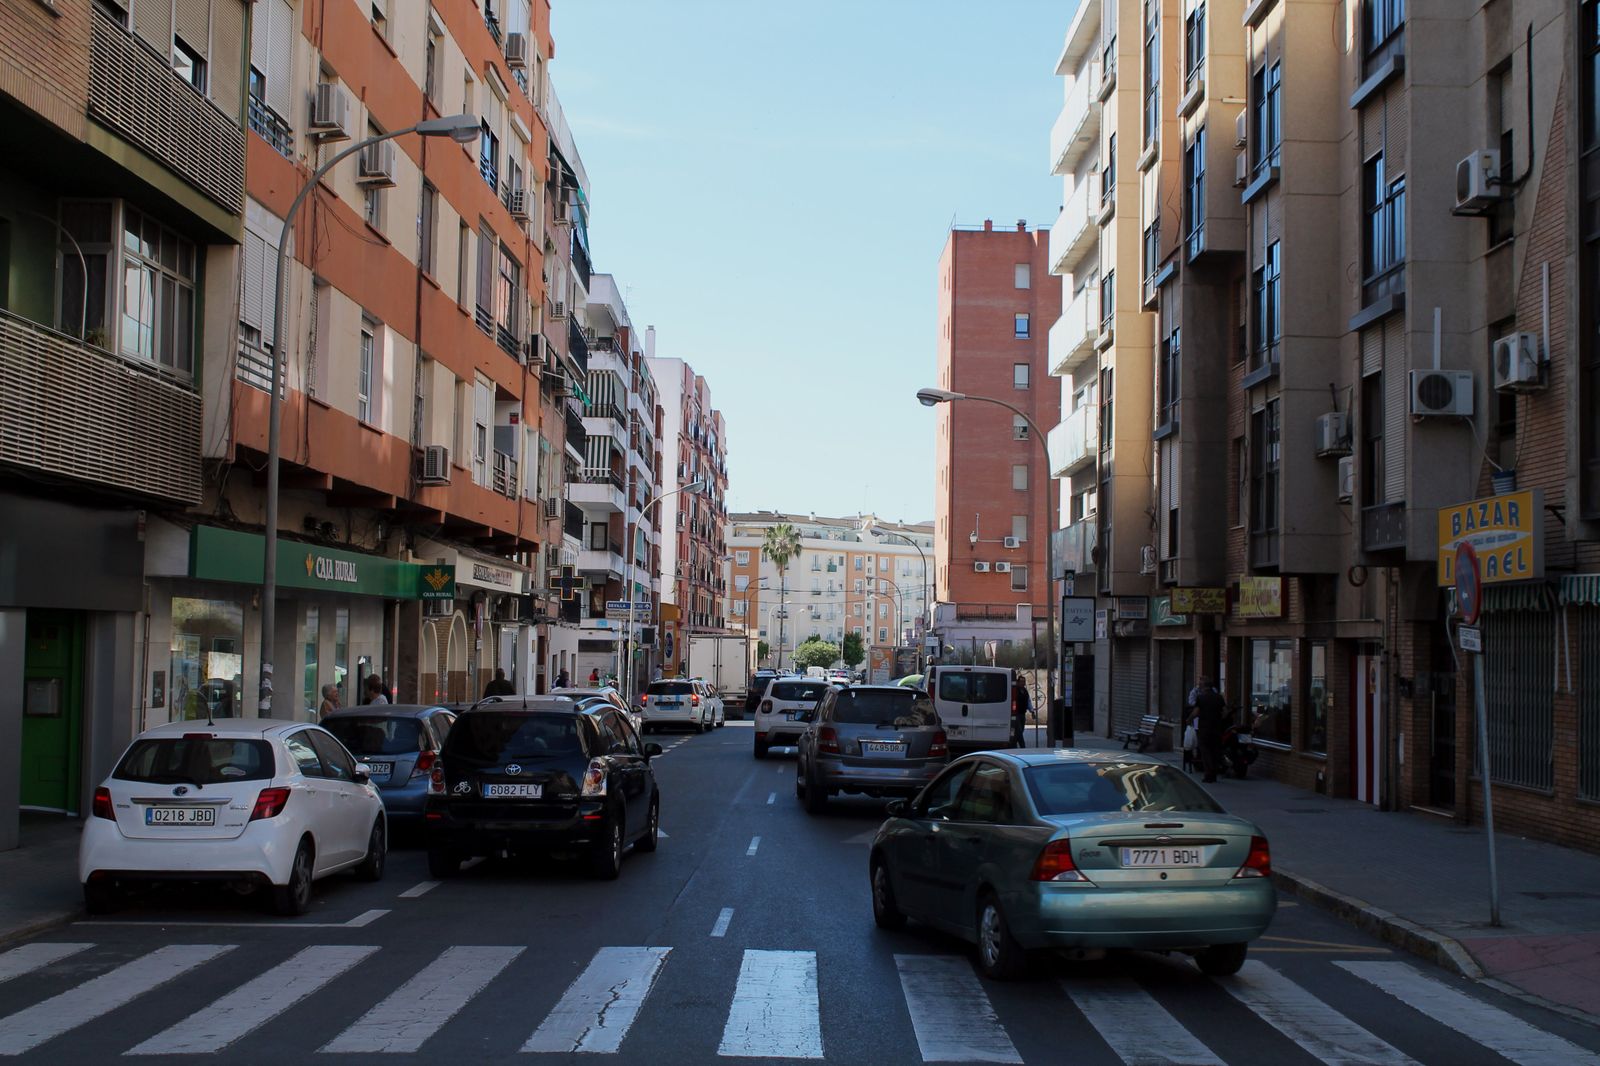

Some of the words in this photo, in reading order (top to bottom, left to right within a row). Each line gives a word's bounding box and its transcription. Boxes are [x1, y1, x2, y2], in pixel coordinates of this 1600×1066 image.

[1451, 500, 1520, 537] BAZAR
[316, 556, 334, 581] CAJA
[335, 560, 358, 583] RURAL
[1445, 545, 1527, 580] IAEL
[490, 785, 516, 795] 6082
[519, 785, 539, 795] FLY
[154, 810, 186, 822] 0218
[189, 810, 213, 822] JBD
[1132, 850, 1167, 865] 7771
[1172, 850, 1200, 865] BDH
